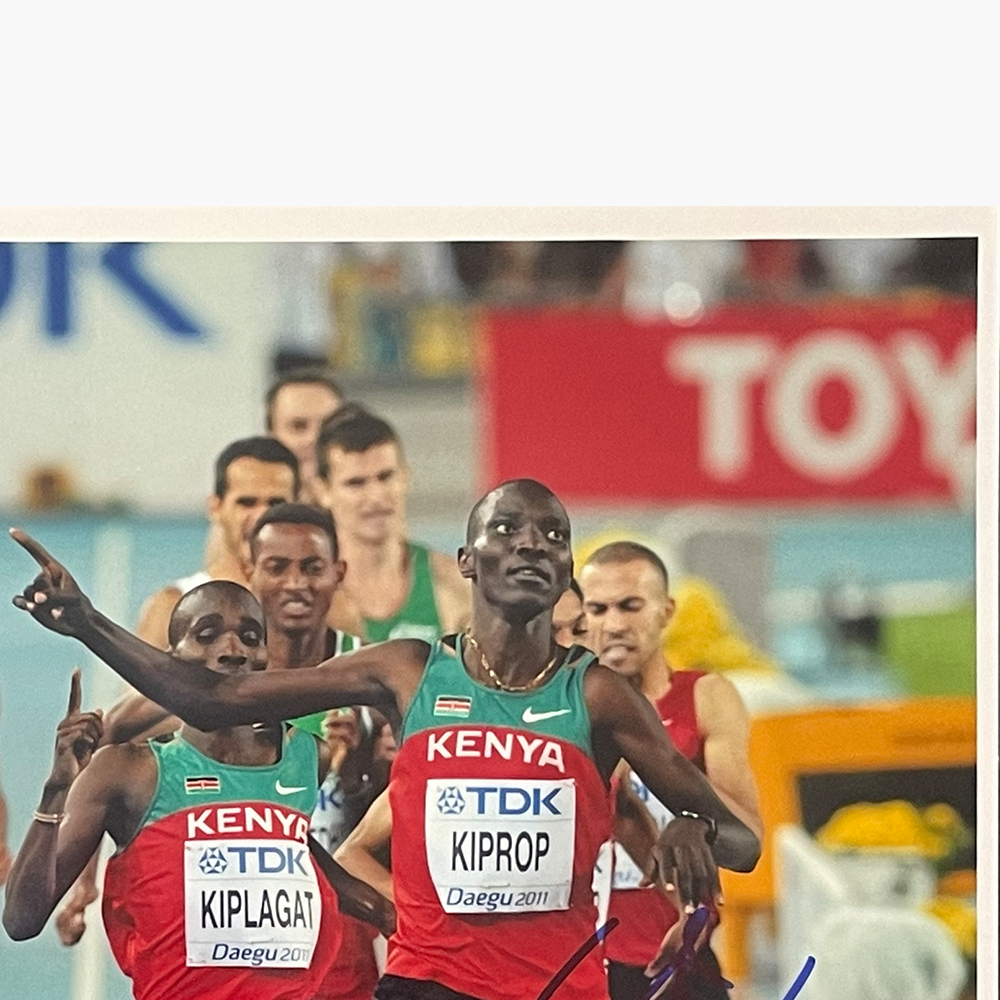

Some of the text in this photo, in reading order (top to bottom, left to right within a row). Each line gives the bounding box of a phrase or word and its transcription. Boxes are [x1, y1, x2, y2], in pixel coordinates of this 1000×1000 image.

[666, 331, 977, 482] TOY
[427, 730, 565, 773] KENYA
[466, 786, 562, 816] TDK
[187, 807, 308, 846] KENYA
[227, 847, 308, 876] TDK
[451, 831, 550, 872] KIPROP
[201, 889, 314, 929] KIPLAGAT
[446, 887, 549, 911] Daegu 2011
[212, 943, 278, 966] Daegu
